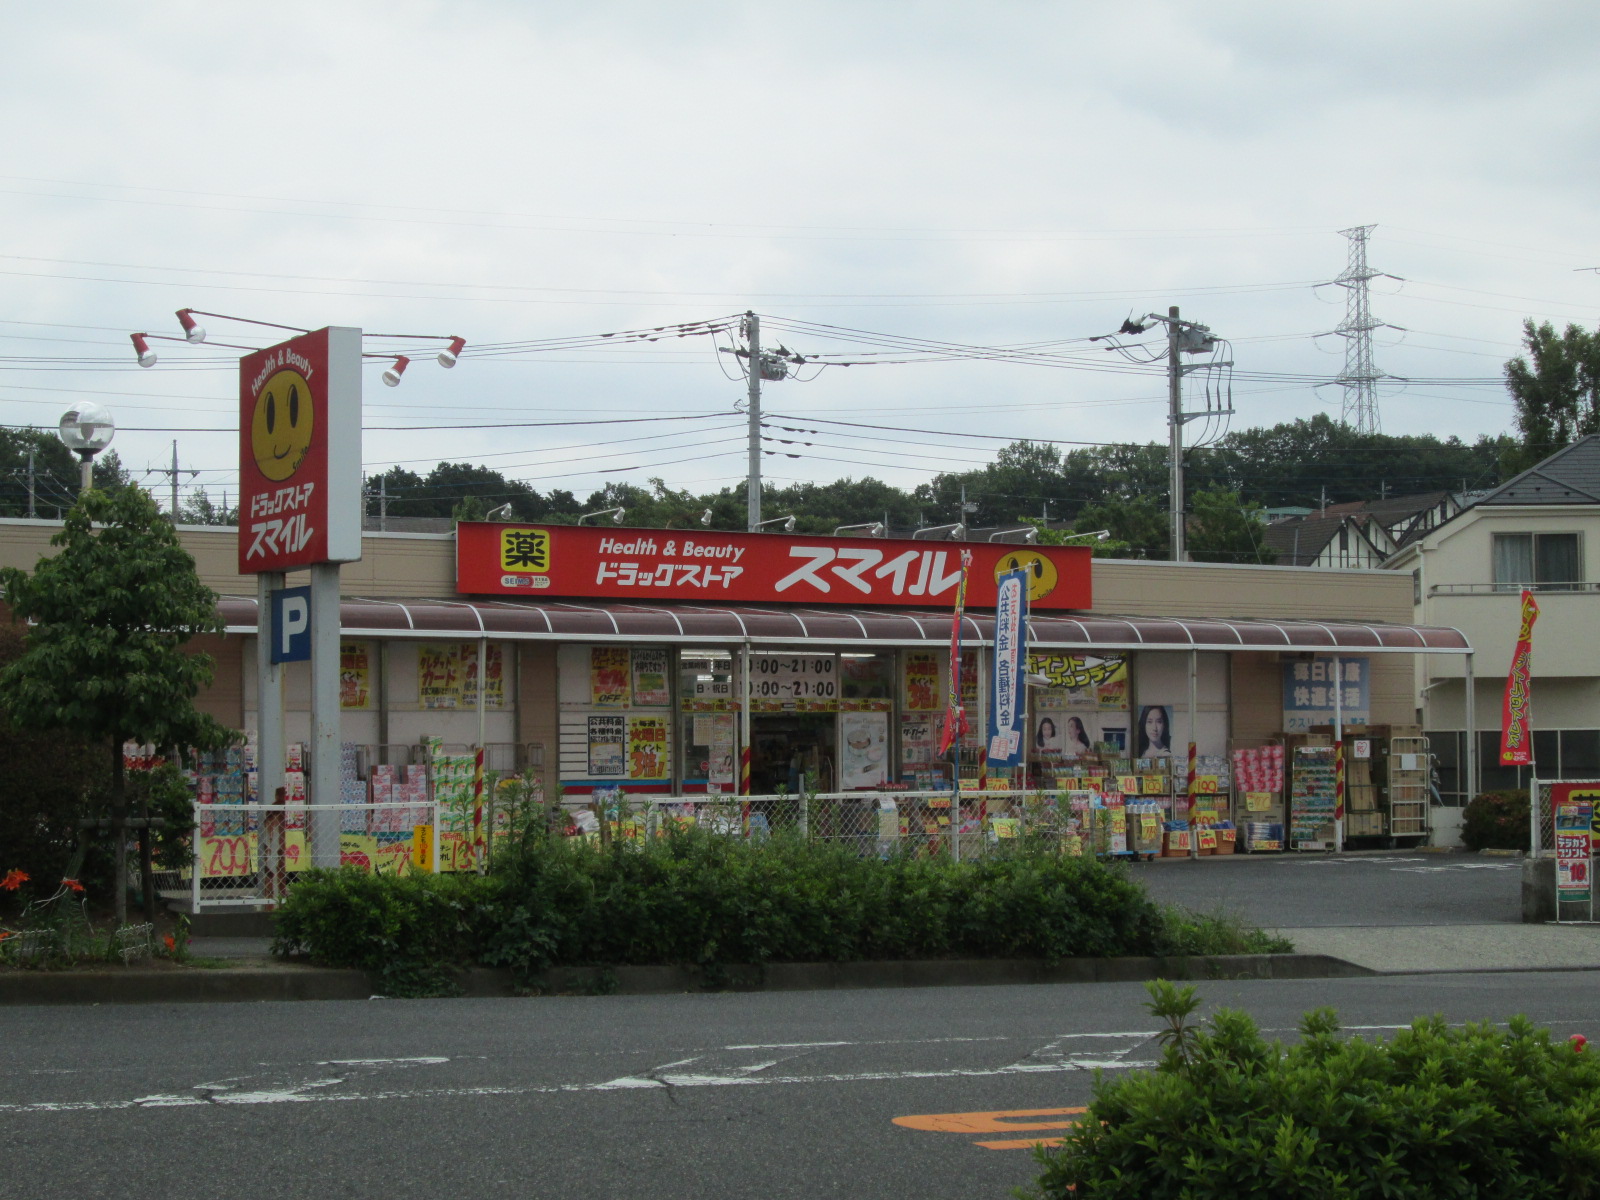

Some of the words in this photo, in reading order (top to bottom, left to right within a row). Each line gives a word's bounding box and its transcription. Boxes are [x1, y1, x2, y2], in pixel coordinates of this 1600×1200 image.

[251, 354, 276, 397] Health
[277, 350, 284, 366] &
[286, 347, 314, 381] Beauty
[250, 482, 315, 519] ドラッグストア
[246, 513, 315, 561] スマイル
[505, 531, 546, 568] 薬
[598, 537, 657, 556] Health
[662, 540, 677, 557] &
[683, 541, 746, 563] Beauty
[504, 577, 531, 586] SEIMS
[596, 562, 744, 589] ドラッグストア
[774, 545, 962, 597] スマイル
[282, 596, 308, 654] P
[714, 660, 731, 671] 平日
[598, 694, 622, 702] OFF
[1102, 695, 1121, 703] OFF
[1293, 686, 1361, 707] 快適生活
[630, 727, 666, 742] 火曜日
[633, 743, 662, 752] ポイント
[1557, 848, 1588, 859] プリント
[1569, 862, 1587, 883] 10
